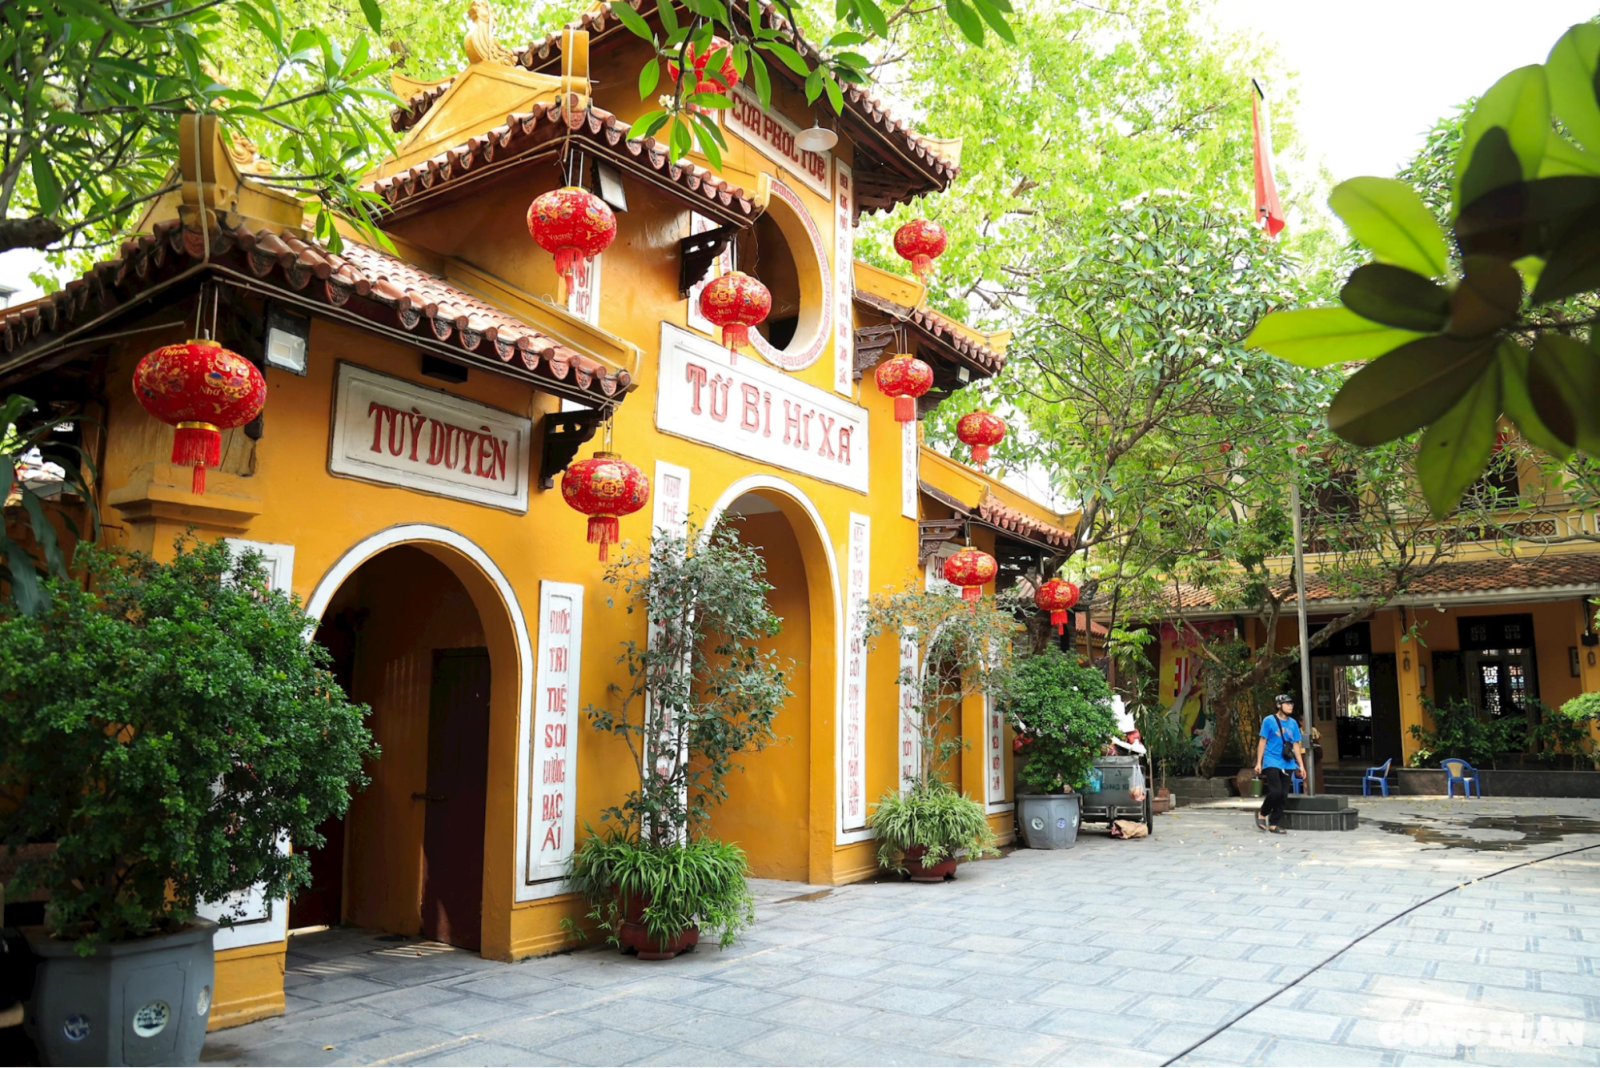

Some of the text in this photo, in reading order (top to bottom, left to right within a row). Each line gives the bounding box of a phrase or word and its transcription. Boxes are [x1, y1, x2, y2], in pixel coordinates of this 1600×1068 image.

[686, 361, 733, 423] TỪ
[425, 416, 509, 483] DUYÊN
[546, 683, 569, 718] TUỆ
[543, 723, 568, 749] SOI
[541, 789, 565, 822] BÁC
[540, 820, 563, 853] ÁI
